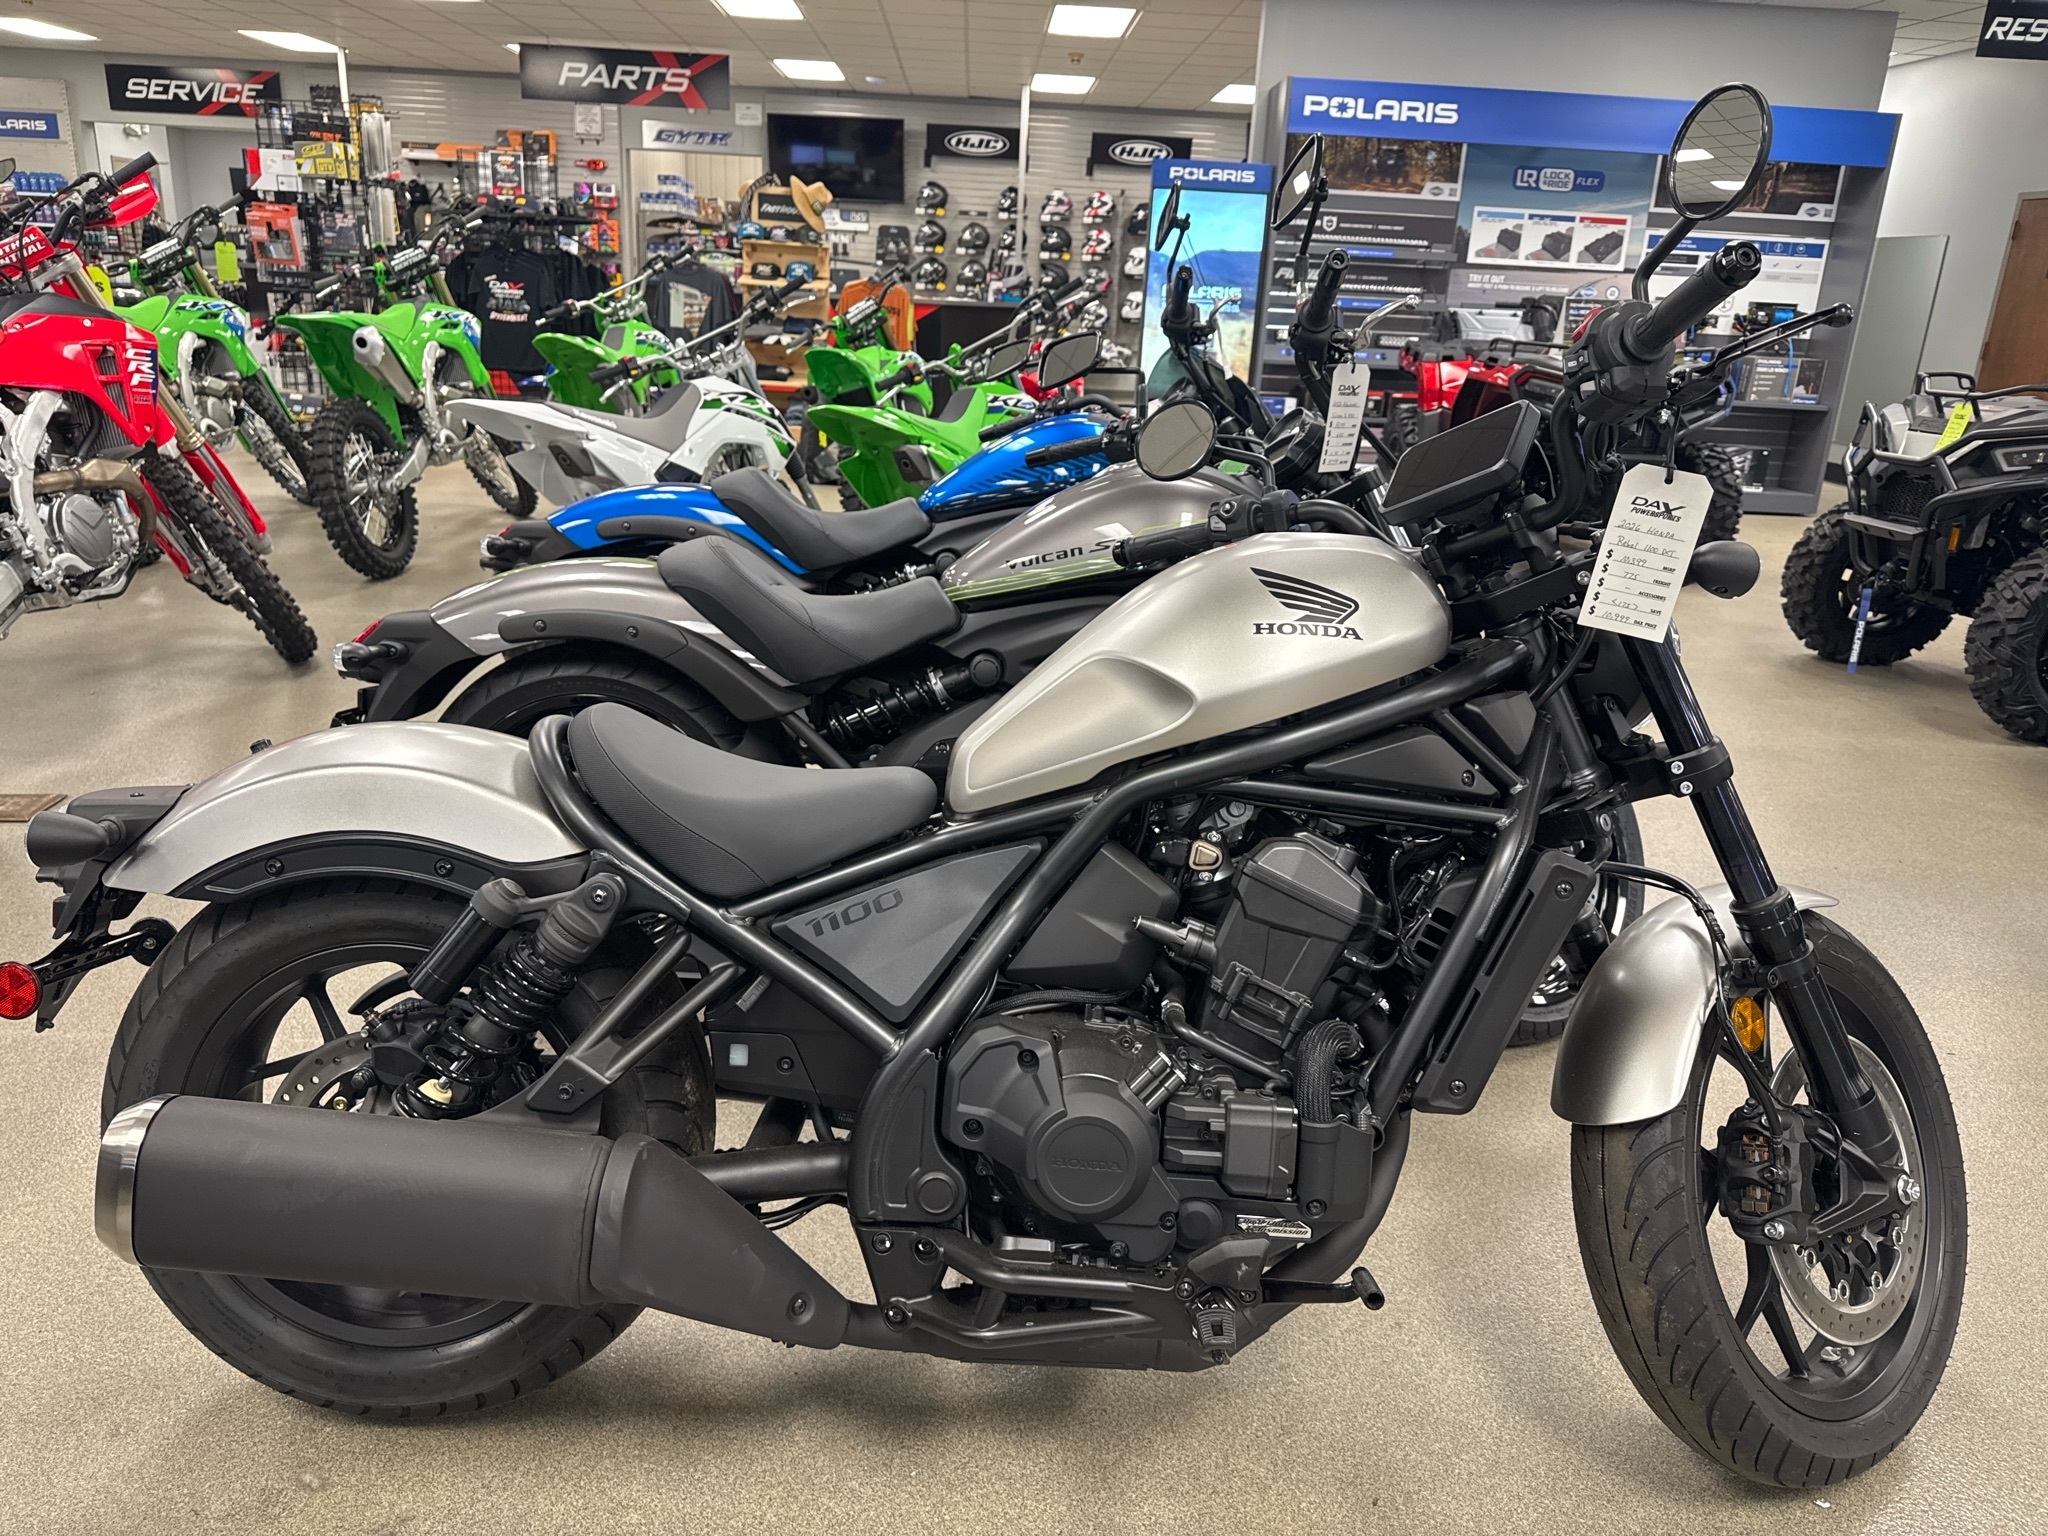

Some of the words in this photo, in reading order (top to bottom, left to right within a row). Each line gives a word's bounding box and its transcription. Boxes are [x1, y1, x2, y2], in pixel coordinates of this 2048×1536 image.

[1984, 16, 2048, 42] RES
[558, 61, 692, 93] PARTS
[125, 77, 264, 104] SERVICE
[1302, 94, 1459, 124] POLARIS
[653, 129, 733, 146] GYTR
[955, 137, 1000, 149] HJC
[1119, 146, 1166, 158] HJC
[1169, 166, 1255, 183] POLARIS
[1516, 169, 1538, 187] LR
[1543, 171, 1571, 180] LOCK
[1576, 177, 1600, 186] FLEX
[125, 348, 156, 387] CRF
[1338, 385, 1361, 394] DAX
[1631, 496, 1686, 514] DAX
[1631, 506, 1681, 522] POWERSPORTS
[1618, 519, 1640, 532] 2026
[1616, 535, 1639, 549] Rebel
[1606, 548, 1614, 559] $
[1601, 562, 1609, 573] $
[1597, 577, 1605, 588] $
[1592, 591, 1600, 601] $
[1588, 605, 1596, 615] $
[1252, 623, 1363, 640] HONDA
[805, 888, 903, 937] 1100
[1052, 1157, 1124, 1173] HONDA
